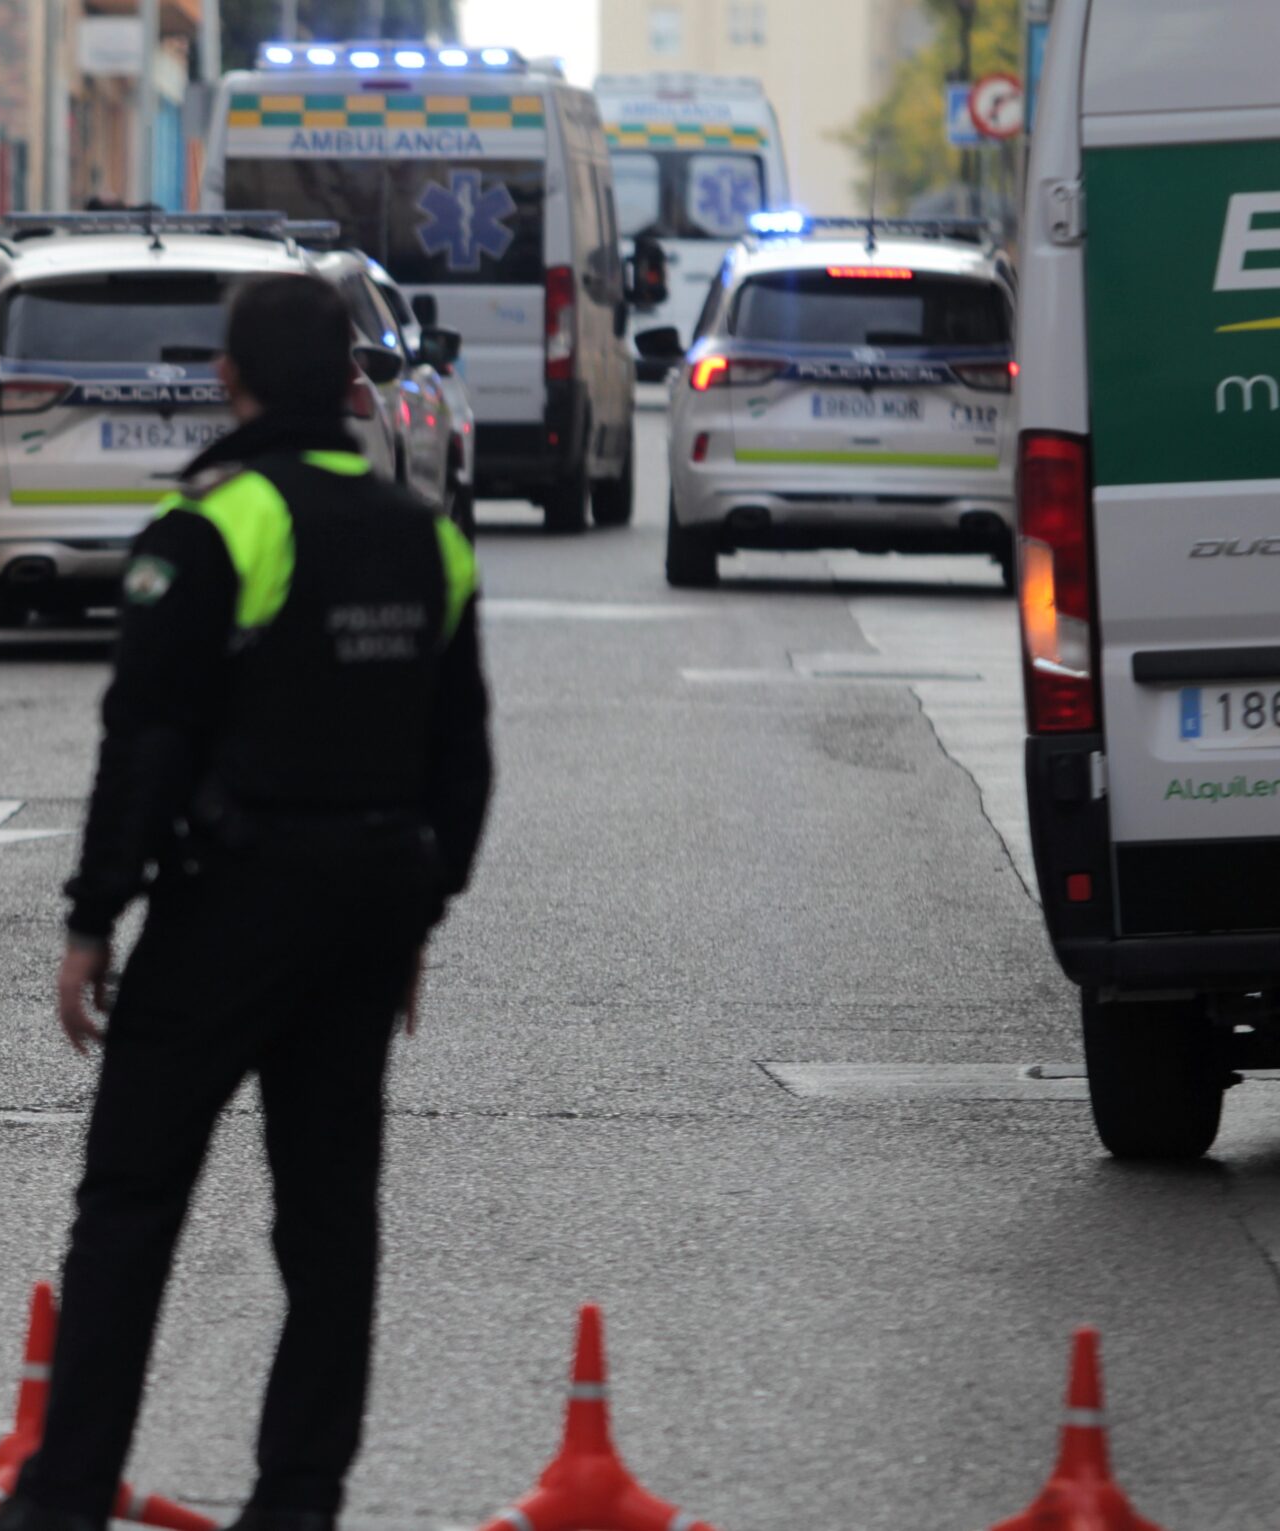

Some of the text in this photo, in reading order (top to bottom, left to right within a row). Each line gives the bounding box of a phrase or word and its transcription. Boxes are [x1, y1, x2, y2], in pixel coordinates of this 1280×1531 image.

[290, 129, 485, 152] AMBULANCIA
[876, 368, 941, 381] LOCAL
[83, 385, 172, 401] POLICIA
